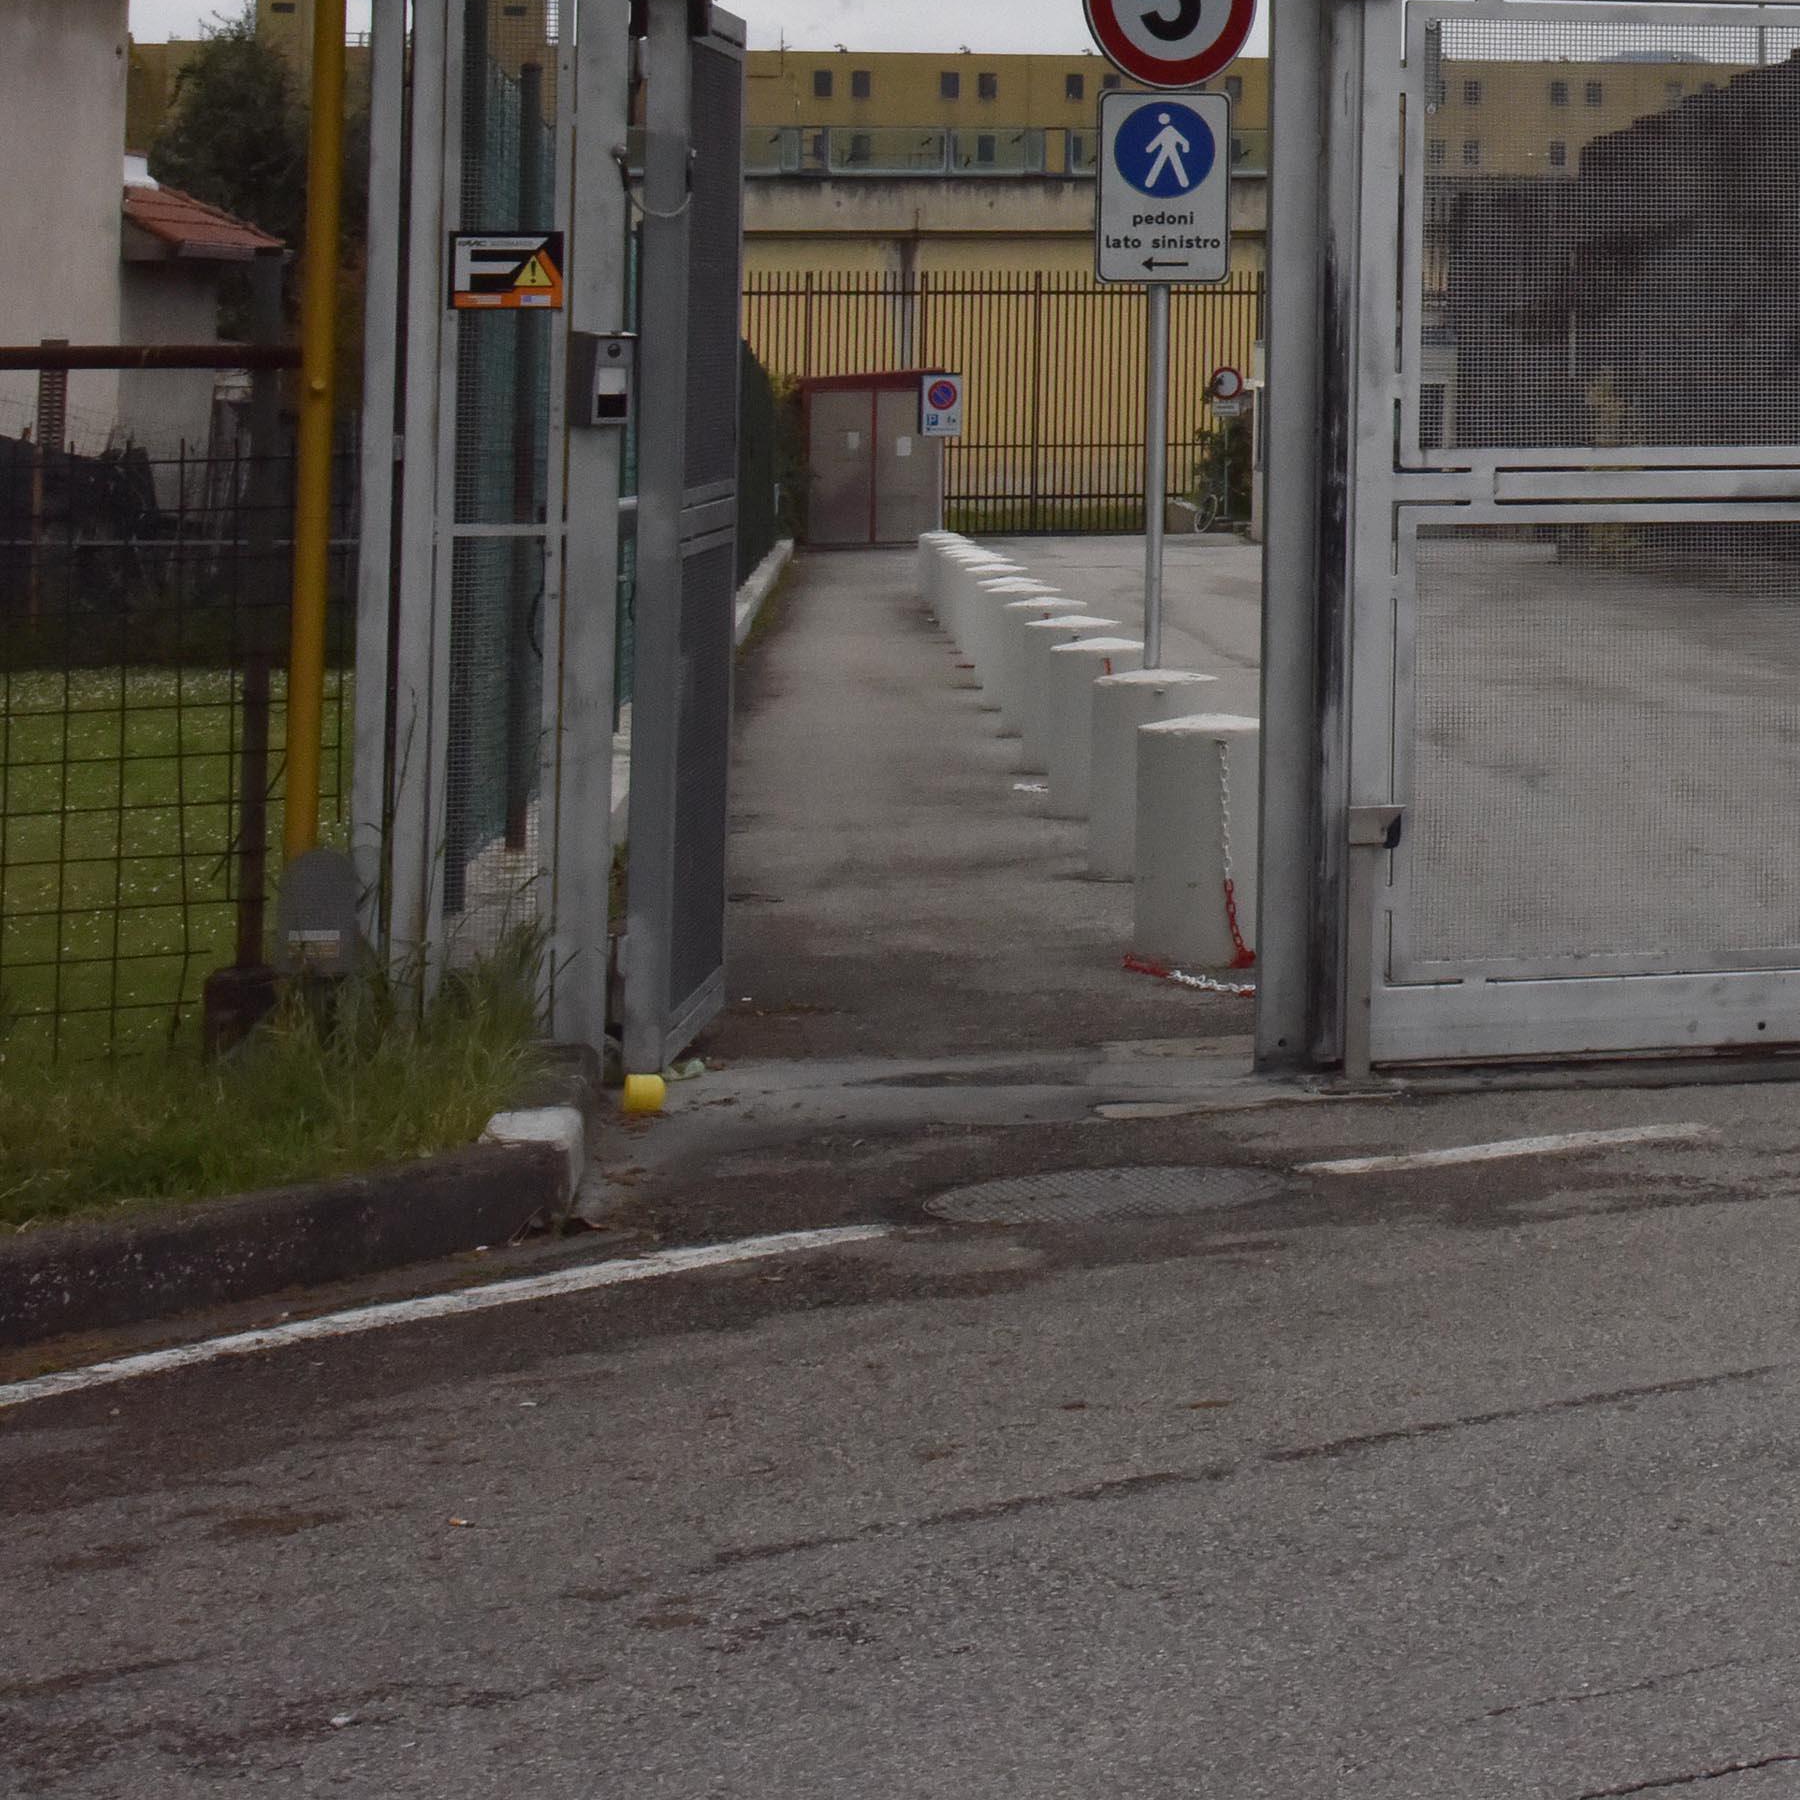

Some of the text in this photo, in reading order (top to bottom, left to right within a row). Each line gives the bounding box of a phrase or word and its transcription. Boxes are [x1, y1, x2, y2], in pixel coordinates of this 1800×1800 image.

[1132, 211, 1194, 227] pedoni
[1106, 235, 1221, 249] lato sinistro
